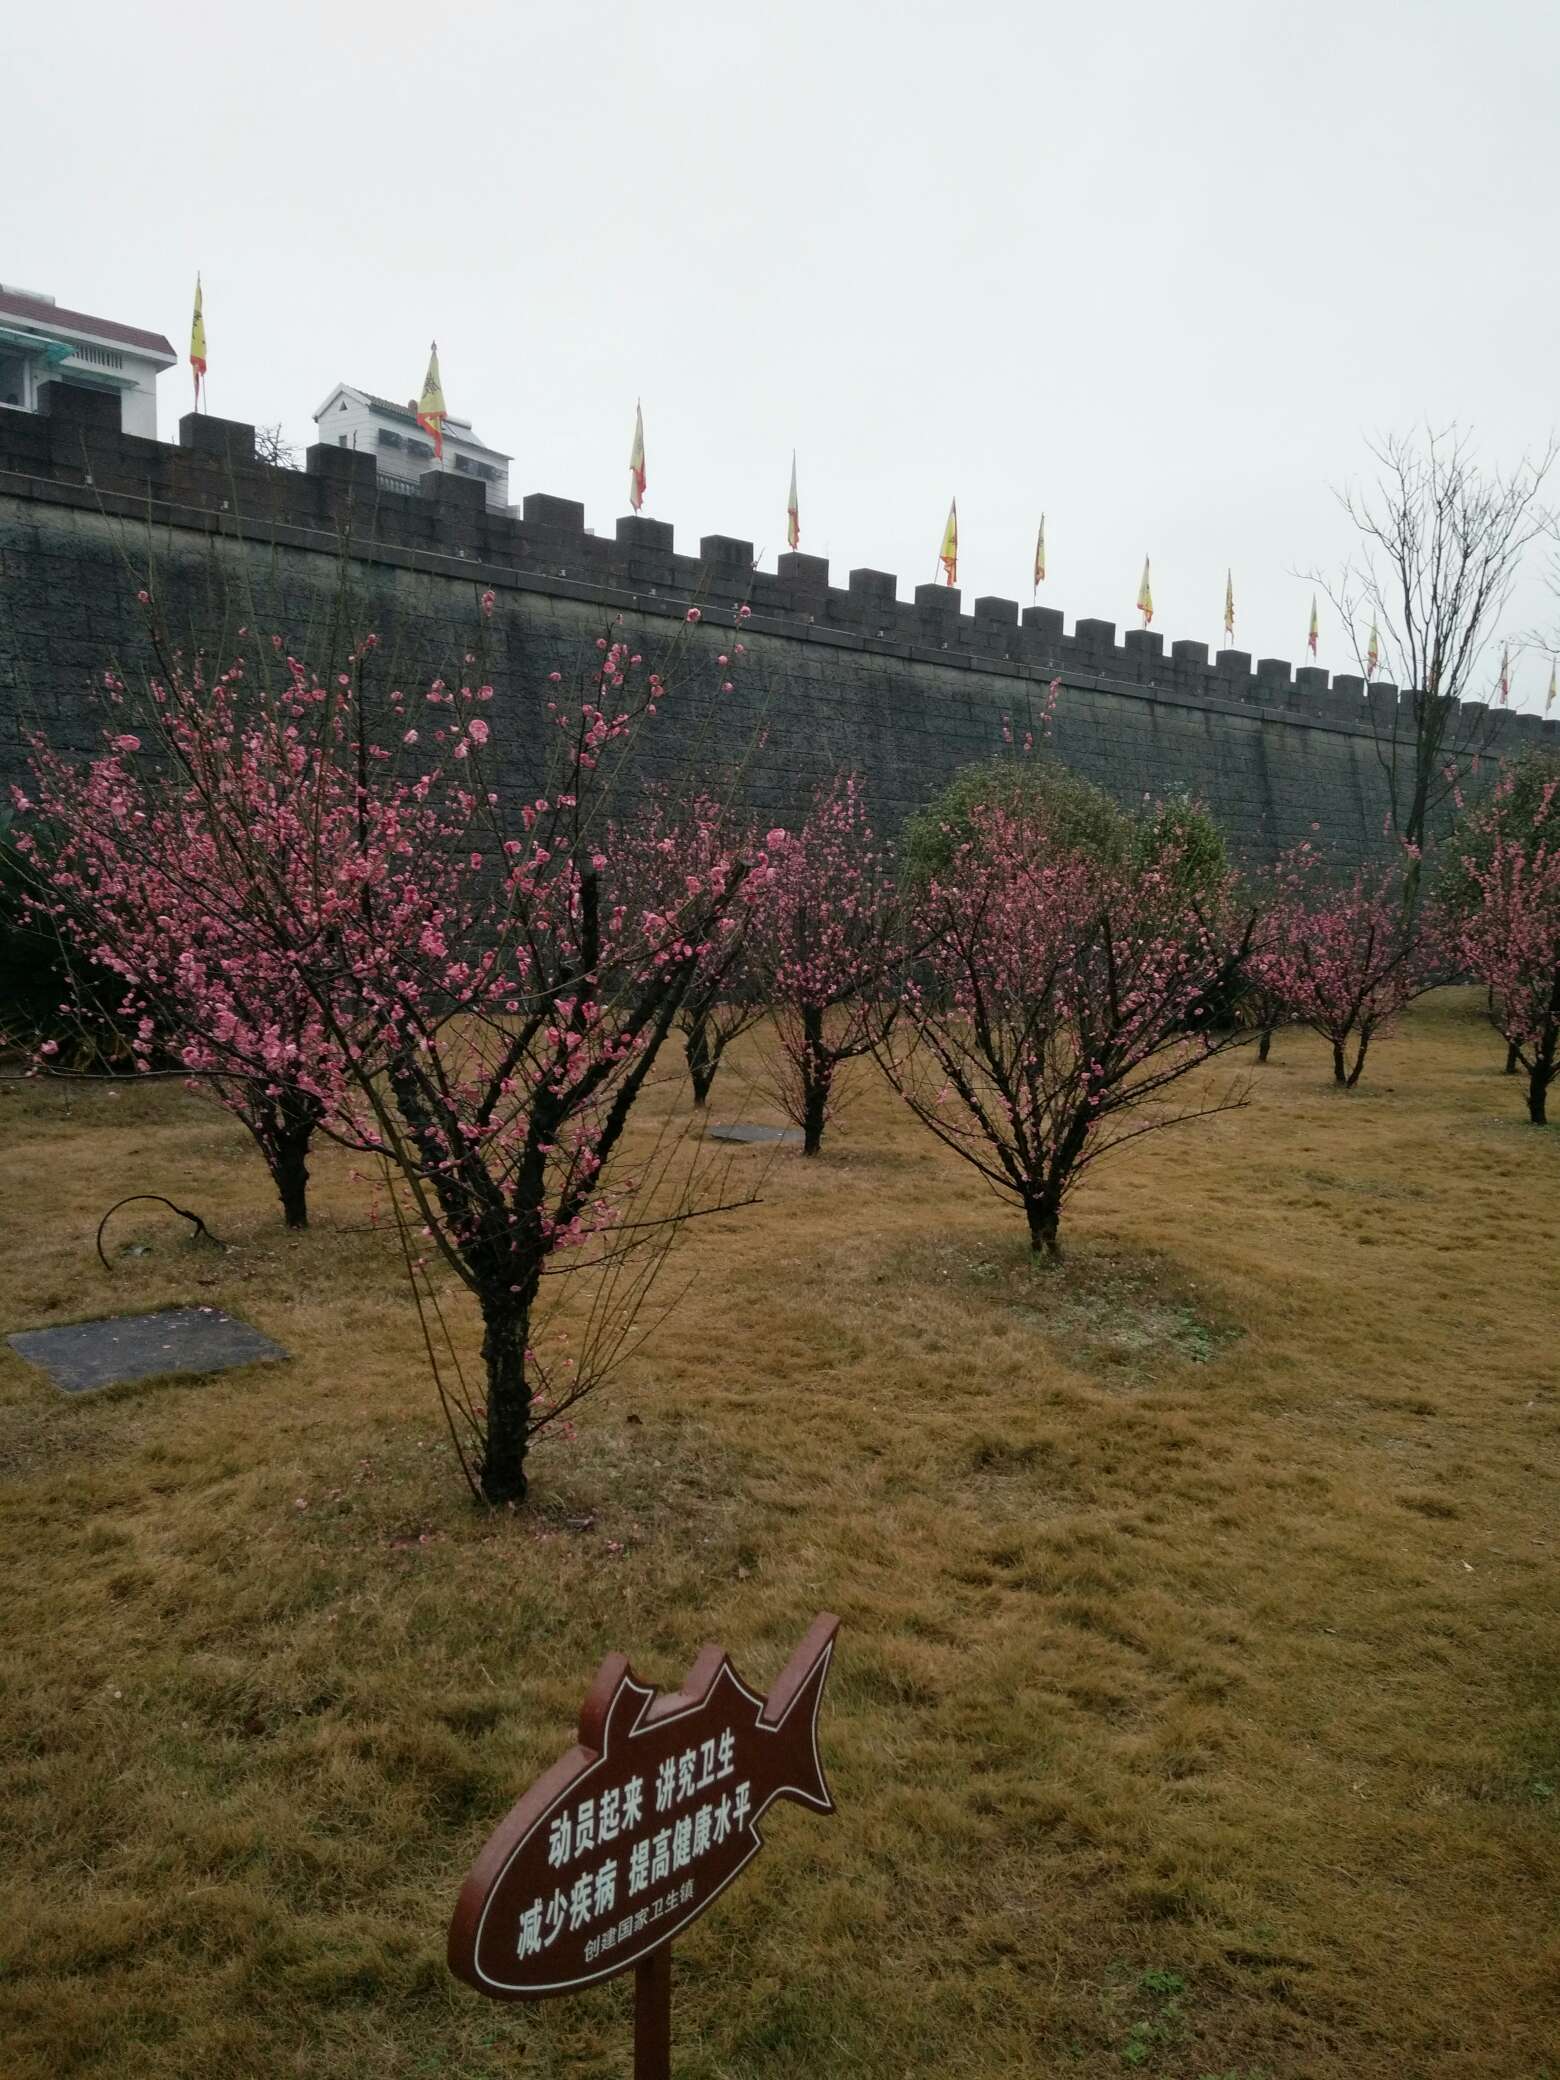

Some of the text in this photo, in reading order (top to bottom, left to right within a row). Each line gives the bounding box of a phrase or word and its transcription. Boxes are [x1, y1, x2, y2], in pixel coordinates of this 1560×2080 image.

[548, 1727, 735, 1869] 动员起来 讲究卫生
[516, 1780, 751, 1960] 减少疾病 提高健康水平
[583, 1878, 695, 1963] 创建国家卫生镇
